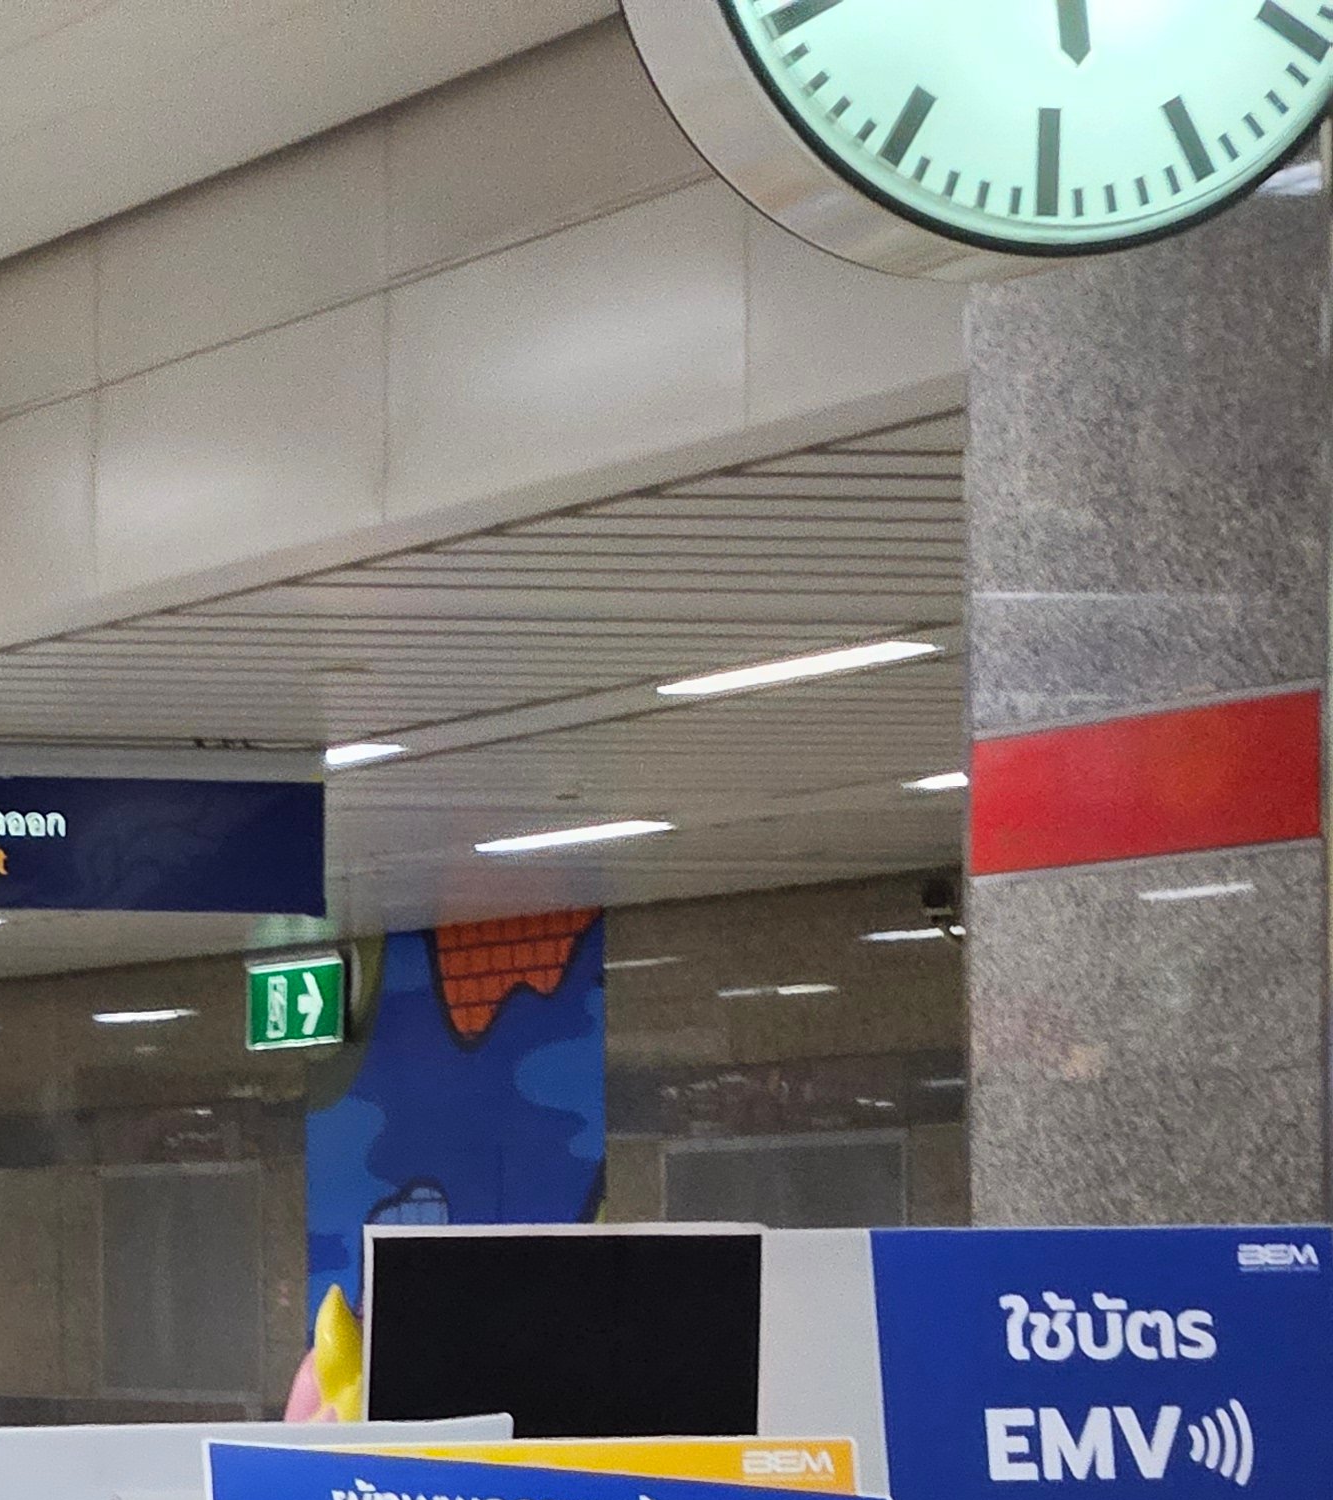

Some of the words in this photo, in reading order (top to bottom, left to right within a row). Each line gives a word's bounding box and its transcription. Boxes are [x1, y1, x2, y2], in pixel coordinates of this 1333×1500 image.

[997, 1290, 1218, 1361] ใช้บัตร
[742, 1449, 835, 1474] BEM
[983, 1404, 1182, 1482] EMV
